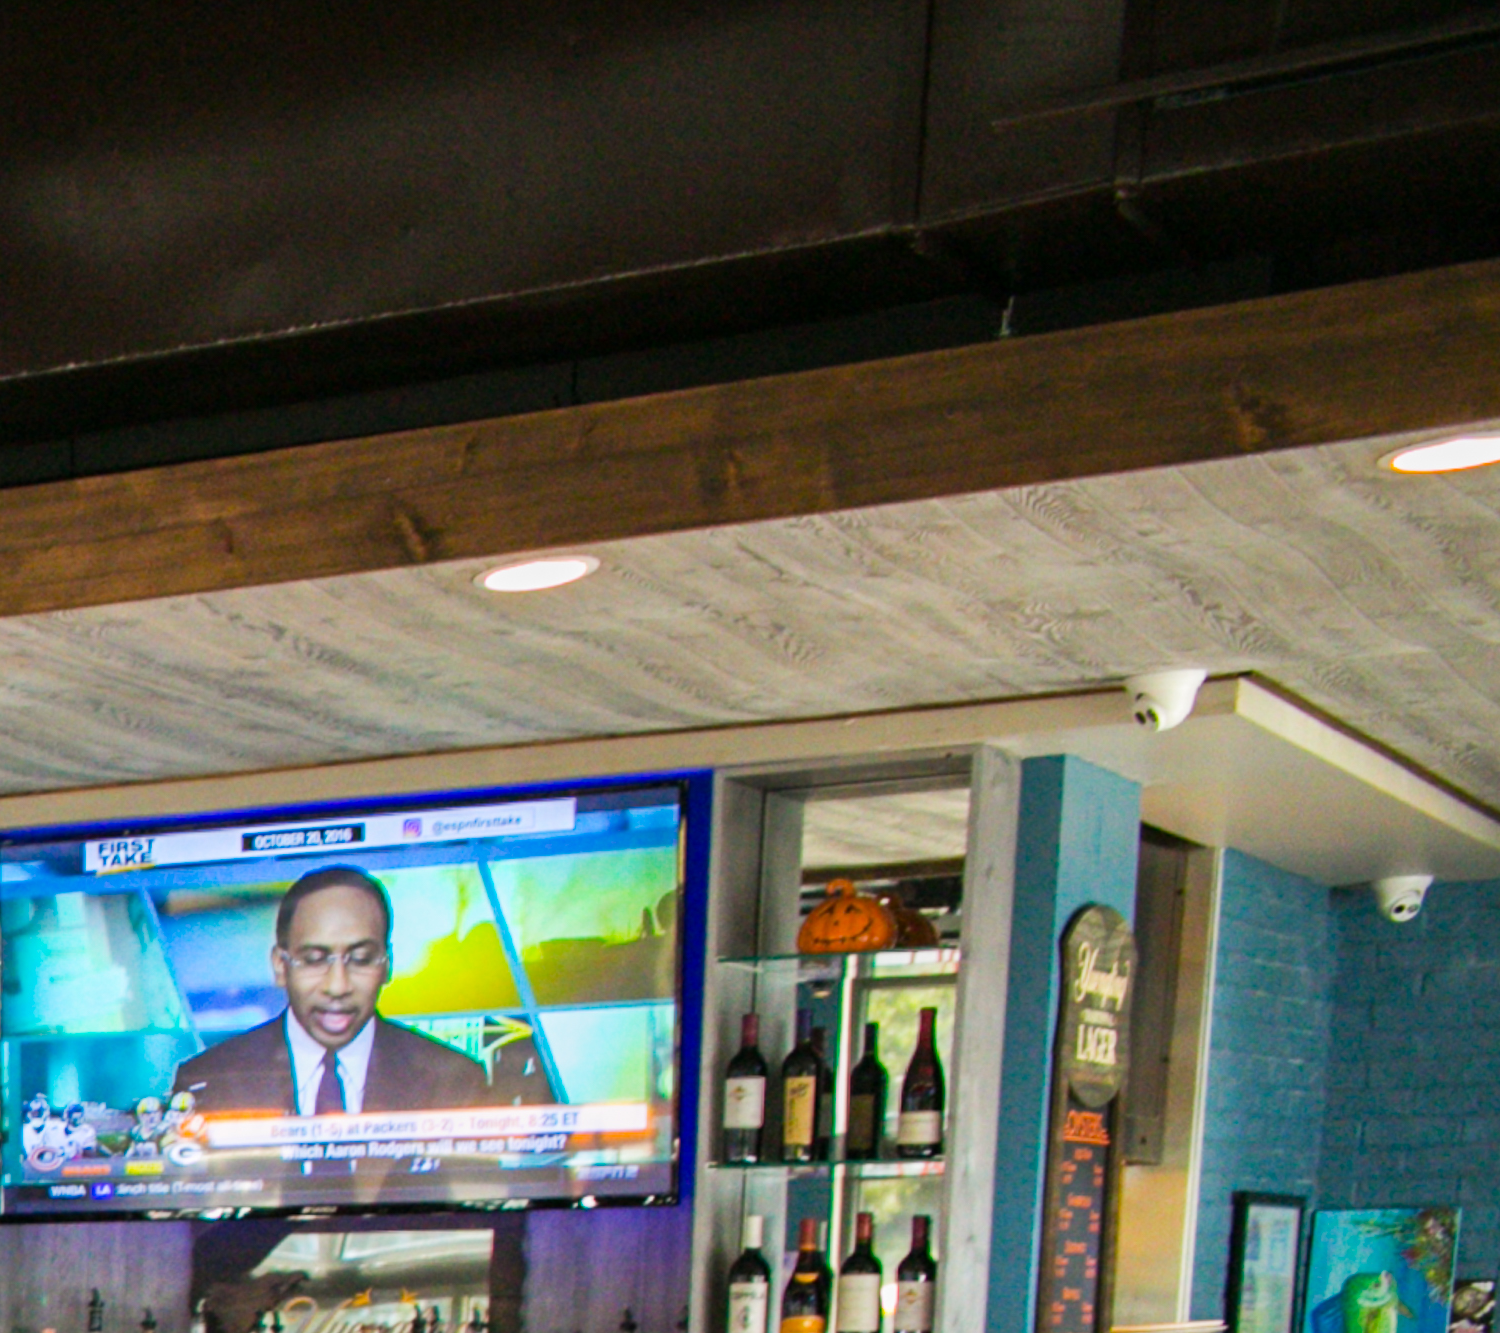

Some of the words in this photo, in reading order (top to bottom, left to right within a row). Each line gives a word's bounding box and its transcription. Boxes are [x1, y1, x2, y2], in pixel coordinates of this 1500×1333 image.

[98, 838, 156, 855] FIRST
[254, 833, 305, 851] OCTOBER
[100, 852, 152, 867] TAKE
[270, 1123, 307, 1139] Bears
[346, 1122, 361, 1136] at
[362, 1119, 418, 1135] Packers
[469, 1115, 524, 1132] Tonight,
[561, 1112, 579, 1126] ET
[325, 1143, 367, 1158] Aaron
[368, 1140, 425, 1159] Rodgers
[506, 1135, 567, 1154] tonight?
